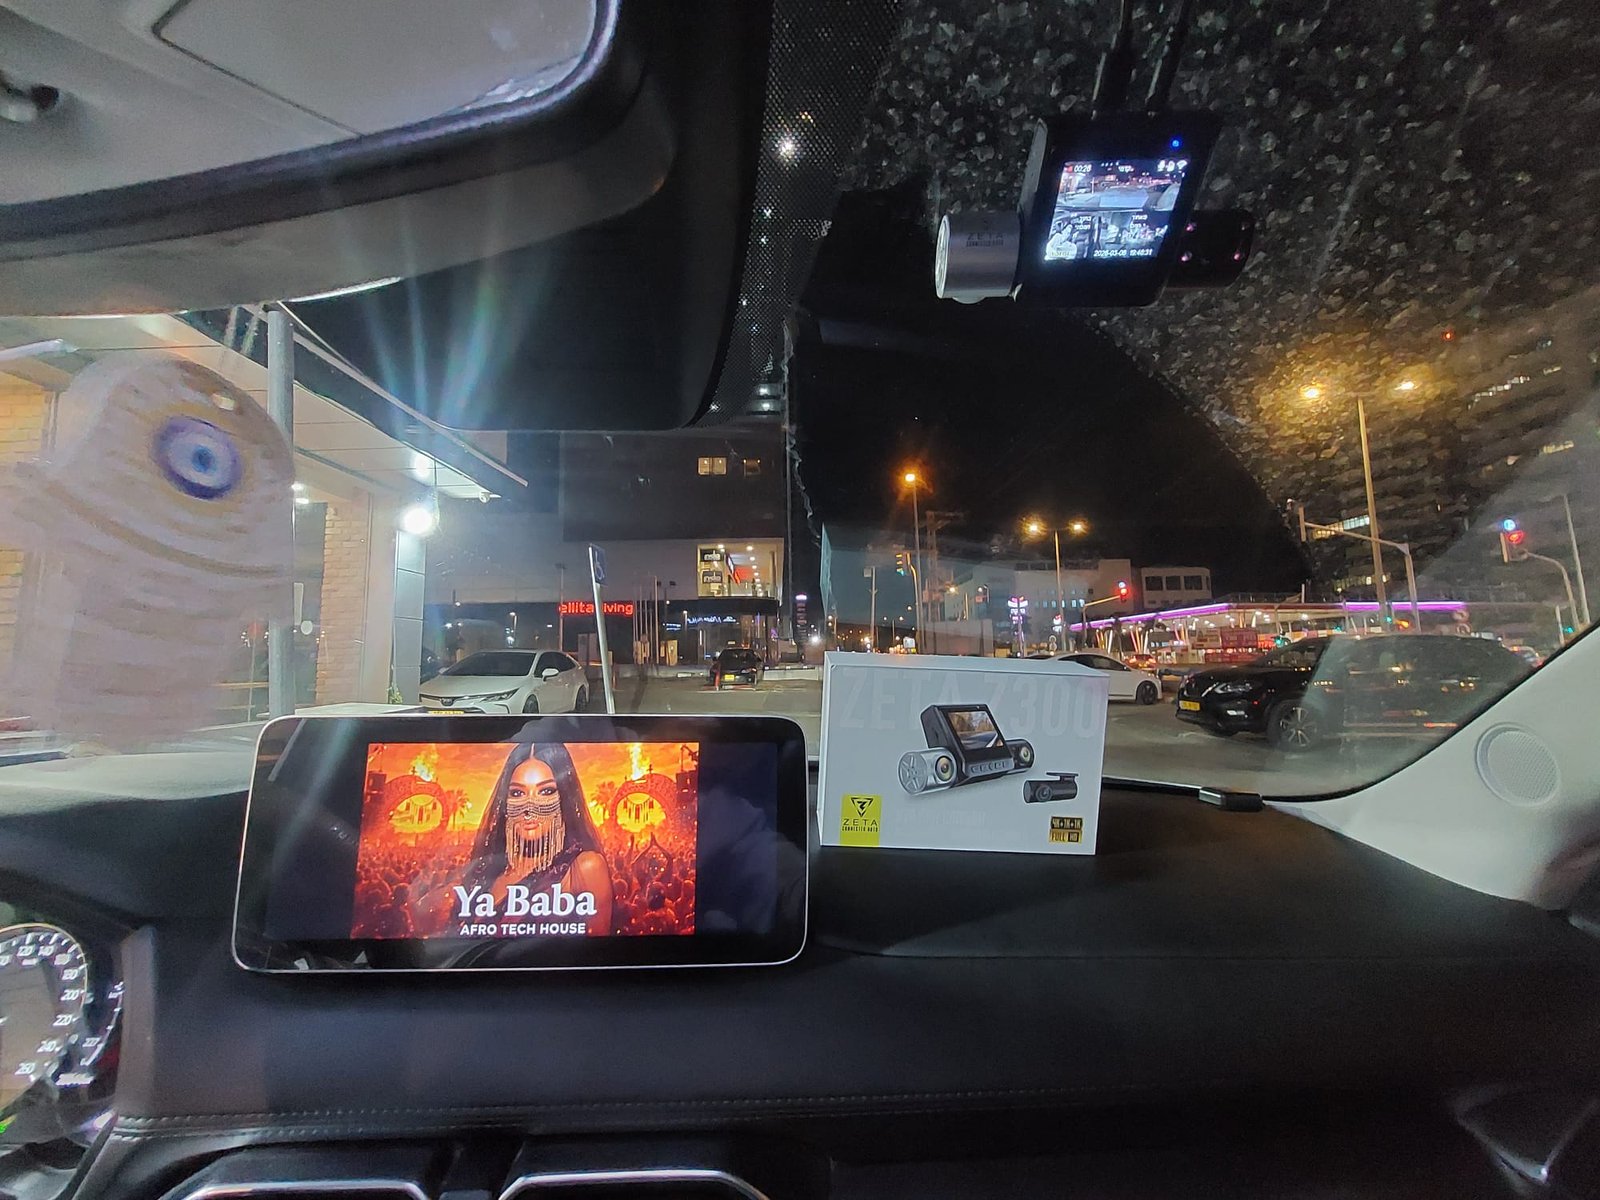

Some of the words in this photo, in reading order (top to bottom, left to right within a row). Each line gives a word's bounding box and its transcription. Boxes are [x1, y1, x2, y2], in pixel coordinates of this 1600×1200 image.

[601, 602, 634, 615] iving
[840, 667, 962, 732] ZETA
[843, 818, 878, 826] ZETA
[453, 884, 497, 918] Ya
[505, 882, 597, 917] Baba
[459, 923, 497, 936] AFRO
[500, 923, 536, 936] TECH
[539, 922, 586, 935] HOUSE
[60, 989, 79, 1001] 200
[53, 1014, 73, 1026] 220
[37, 1041, 57, 1053] 240
